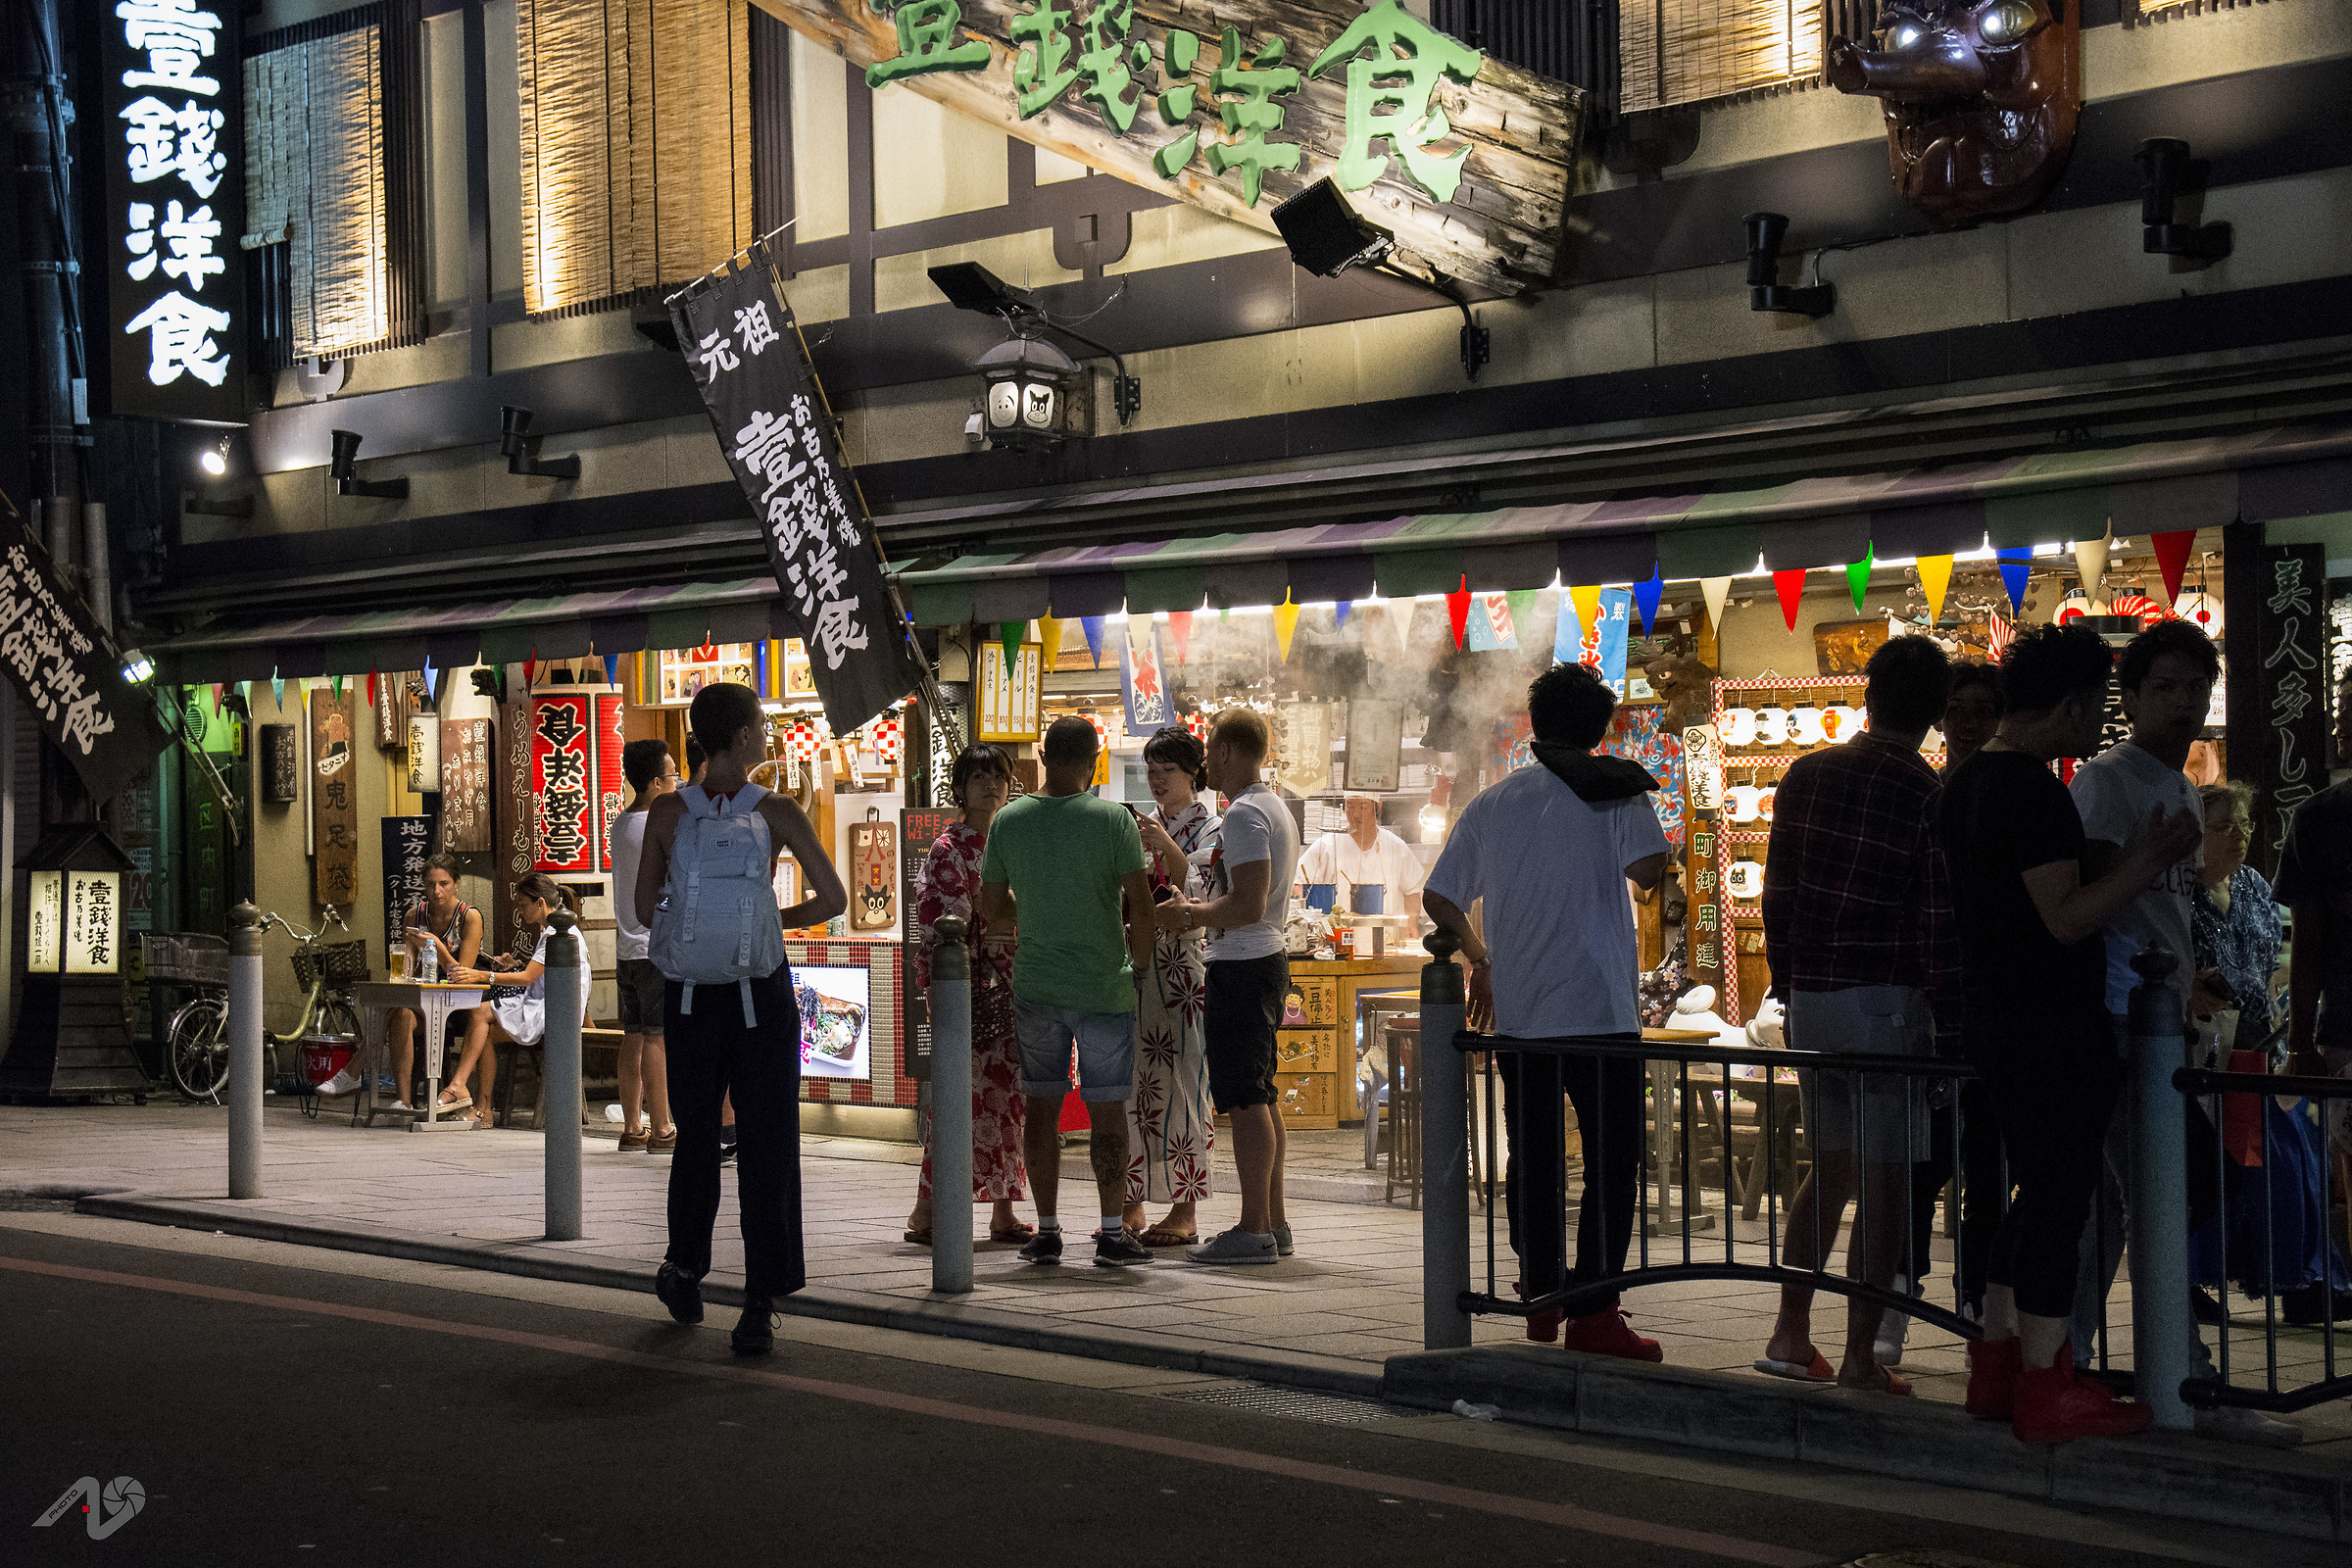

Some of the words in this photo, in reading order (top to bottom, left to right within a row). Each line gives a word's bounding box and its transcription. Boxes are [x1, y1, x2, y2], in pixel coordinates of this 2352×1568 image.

[700, 299, 781, 384] 元祖
[452, 753, 464, 835] あります
[906, 814, 941, 827] FREE
[1309, 987, 1322, 1023] 一旦停止
